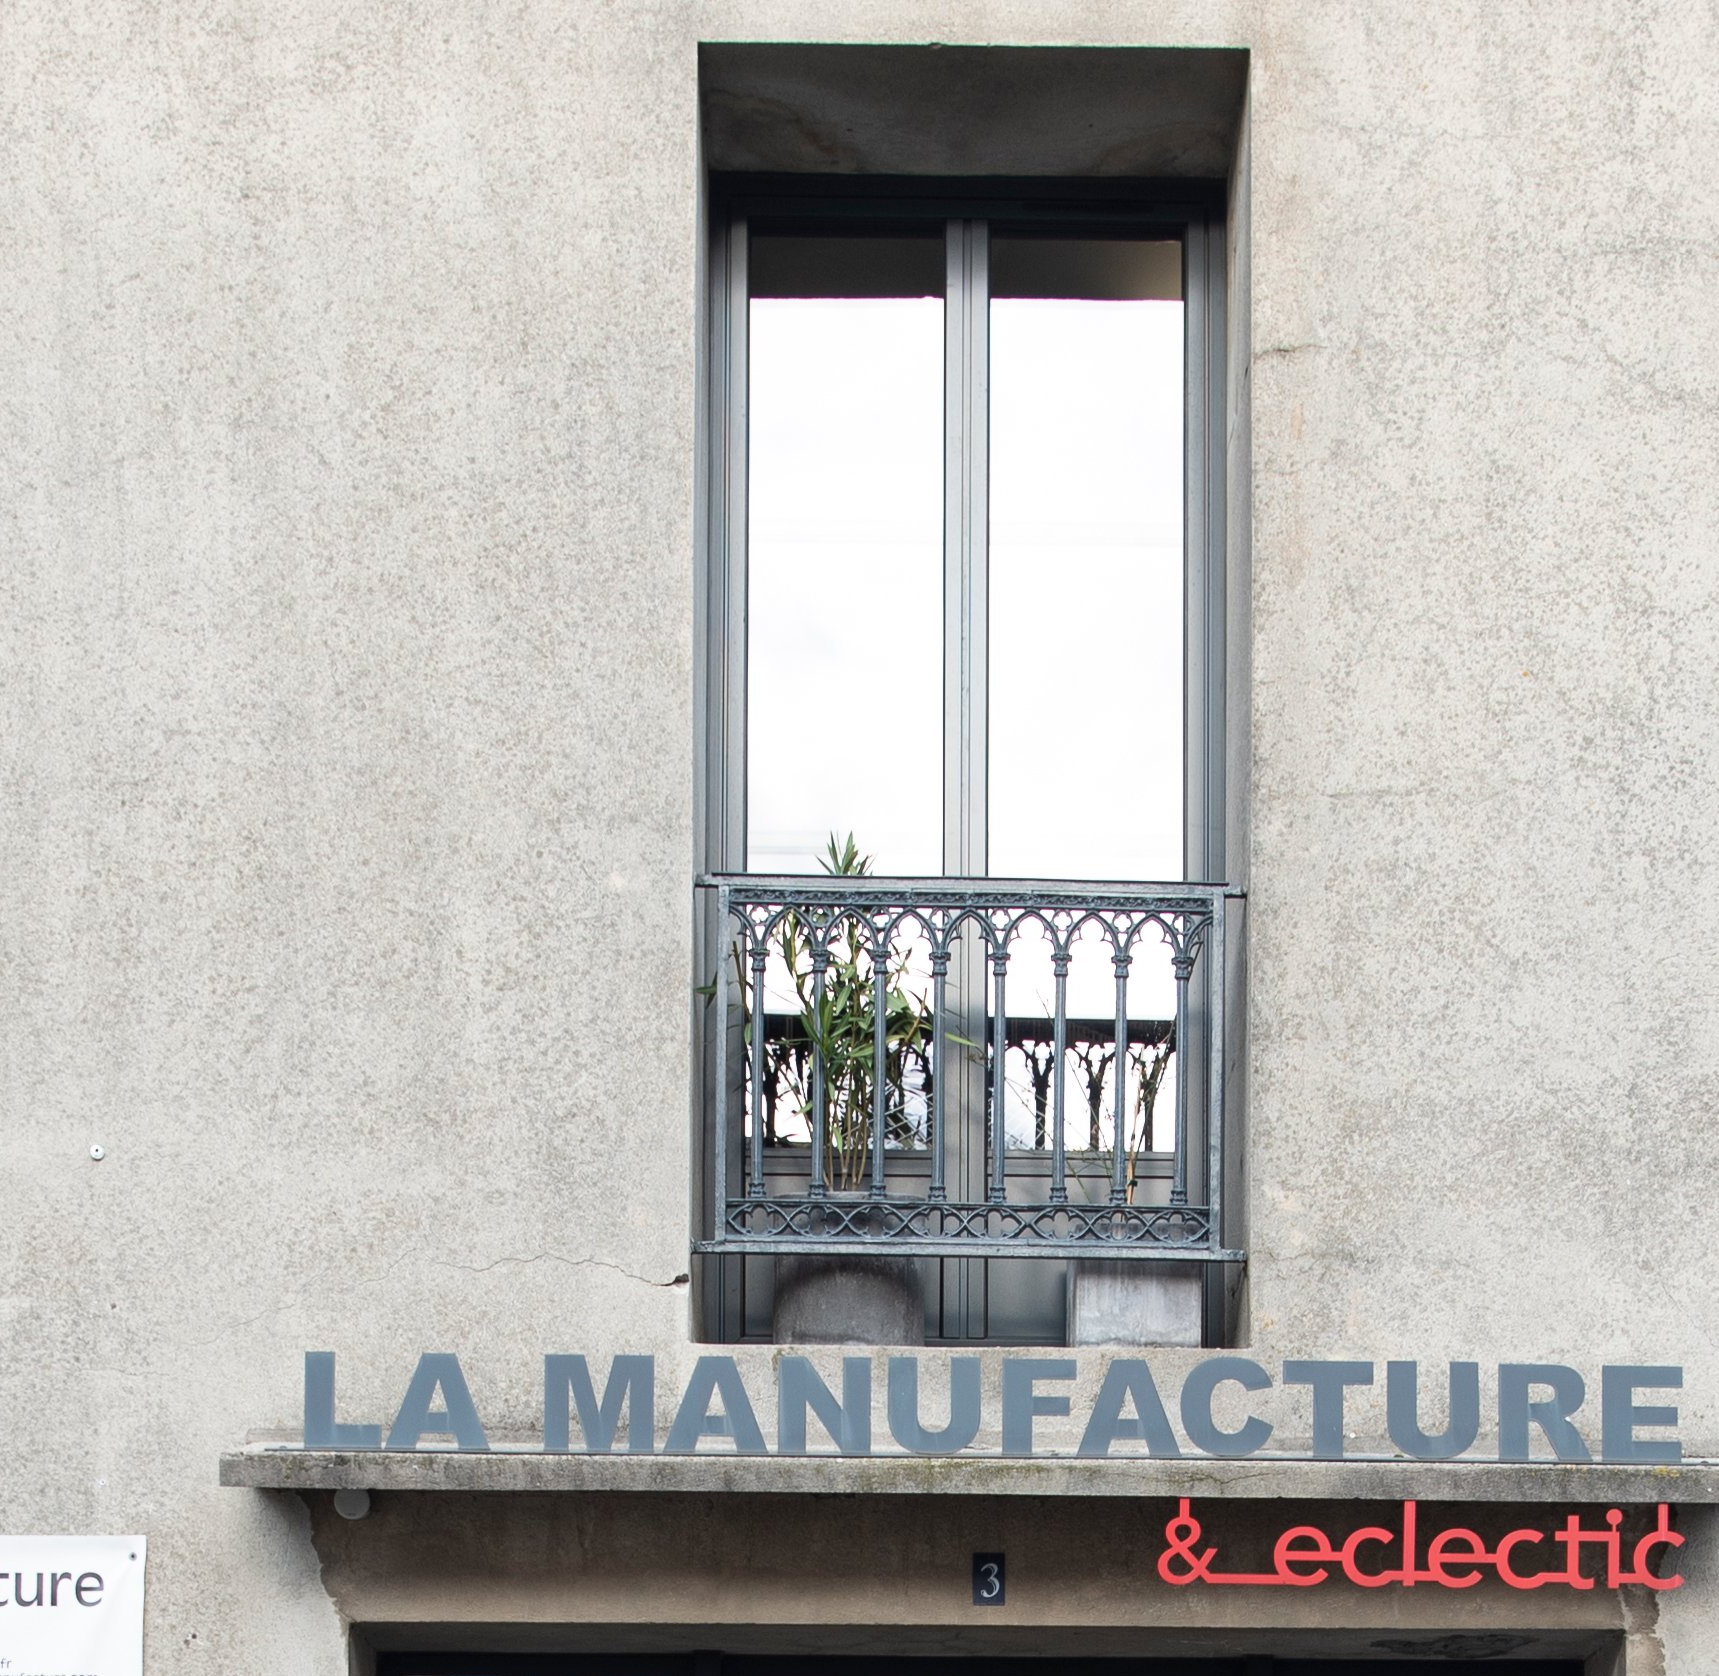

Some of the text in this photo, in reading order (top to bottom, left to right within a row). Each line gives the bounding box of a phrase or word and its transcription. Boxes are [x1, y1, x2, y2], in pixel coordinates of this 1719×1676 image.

[304, 1351, 1684, 1462] LA MANUFACTURE
[980, 1562, 1000, 1598] 3
[1157, 1498, 1687, 1591] & eclectic
